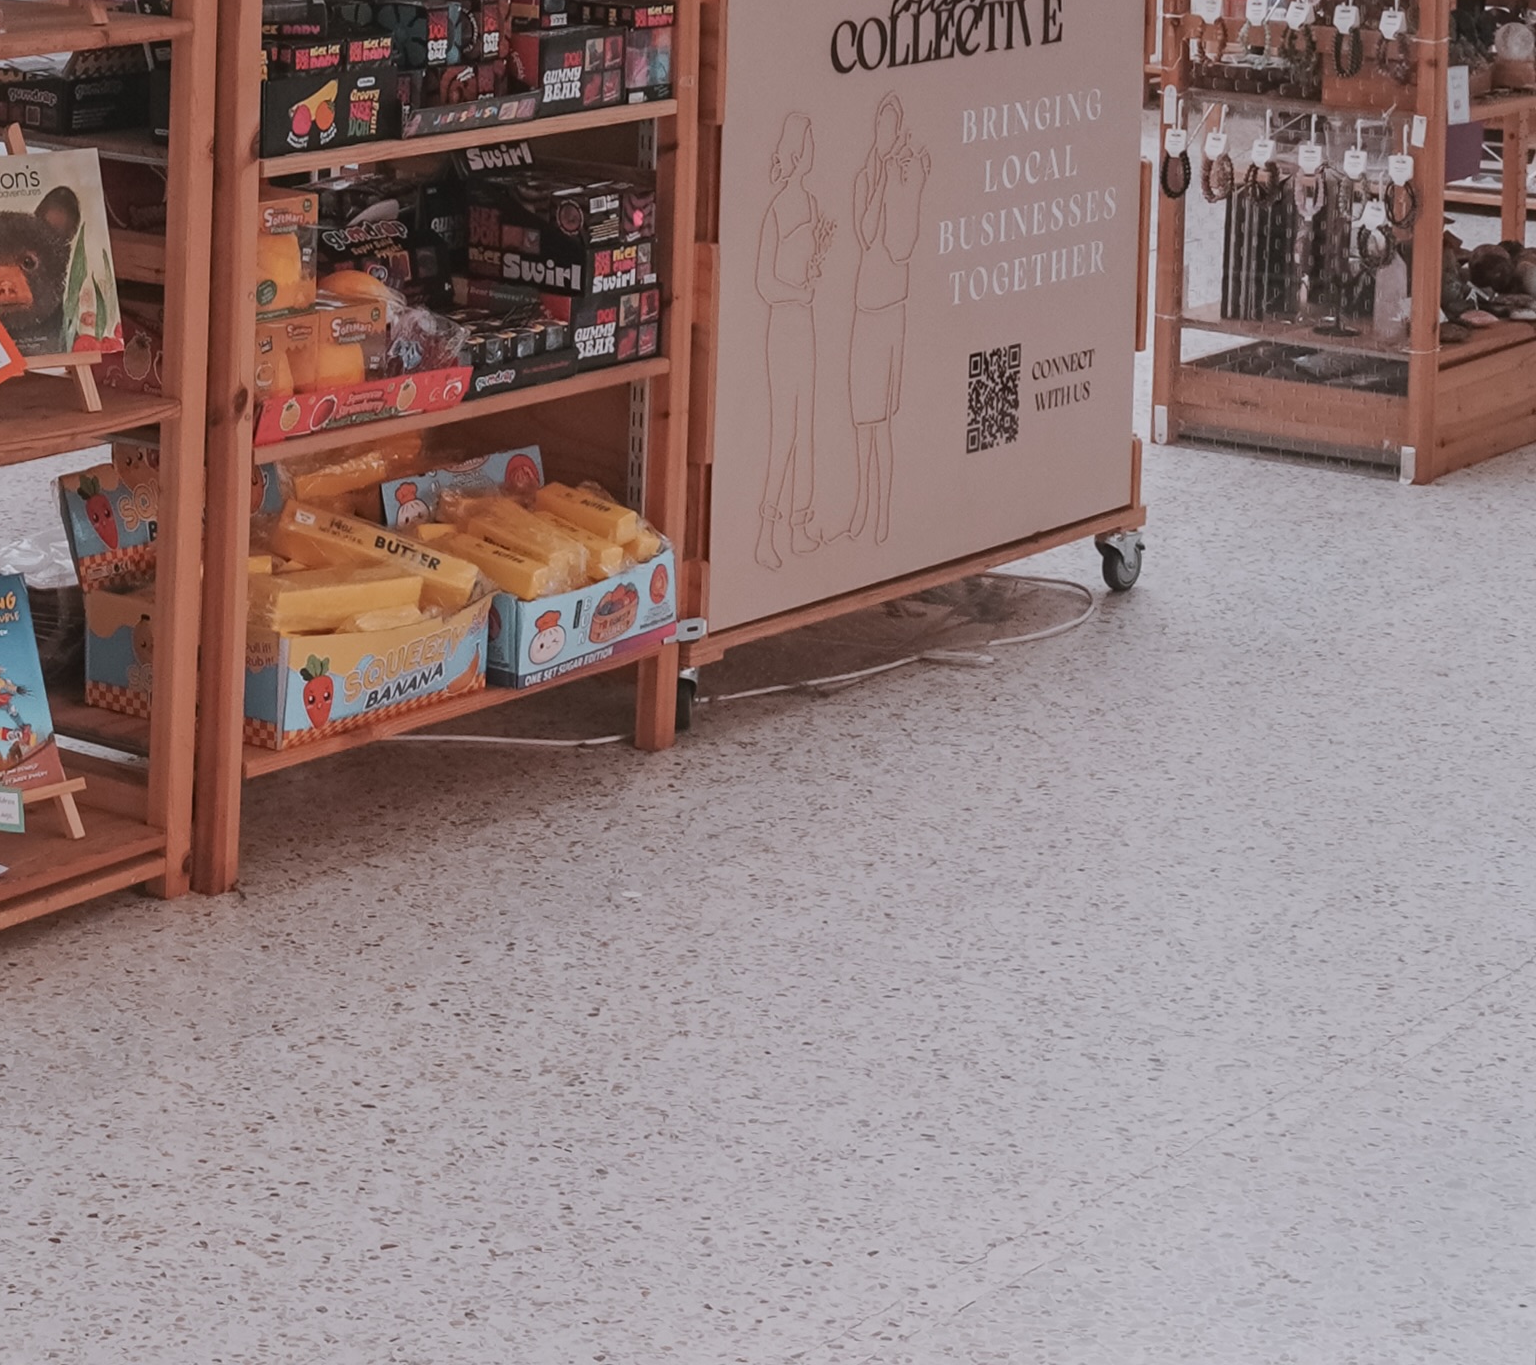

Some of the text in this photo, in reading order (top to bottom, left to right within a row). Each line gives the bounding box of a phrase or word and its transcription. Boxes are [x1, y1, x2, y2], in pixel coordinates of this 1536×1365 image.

[542, 82, 581, 102] BEAR
[543, 66, 582, 84] GUMMY
[962, 88, 1103, 144] BRINGING
[466, 141, 533, 170] Swirl
[983, 144, 1078, 193] LOCAL
[322, 221, 408, 250] gumdrop
[937, 187, 1118, 255] BUSINESSES
[503, 251, 582, 291] Swirl
[592, 269, 636, 294] Swirl
[948, 240, 1105, 306] TOGETHER
[574, 322, 616, 342] GUMMY
[1031, 349, 1096, 381] CONNECT
[1034, 380, 1091, 412] WITH US
[374, 534, 447, 571] BUTTER
[343, 623, 465, 705] SQUEEZY
[524, 645, 614, 687] ONE SET SUGAR EDITION
[365, 660, 445, 710] BANANA
